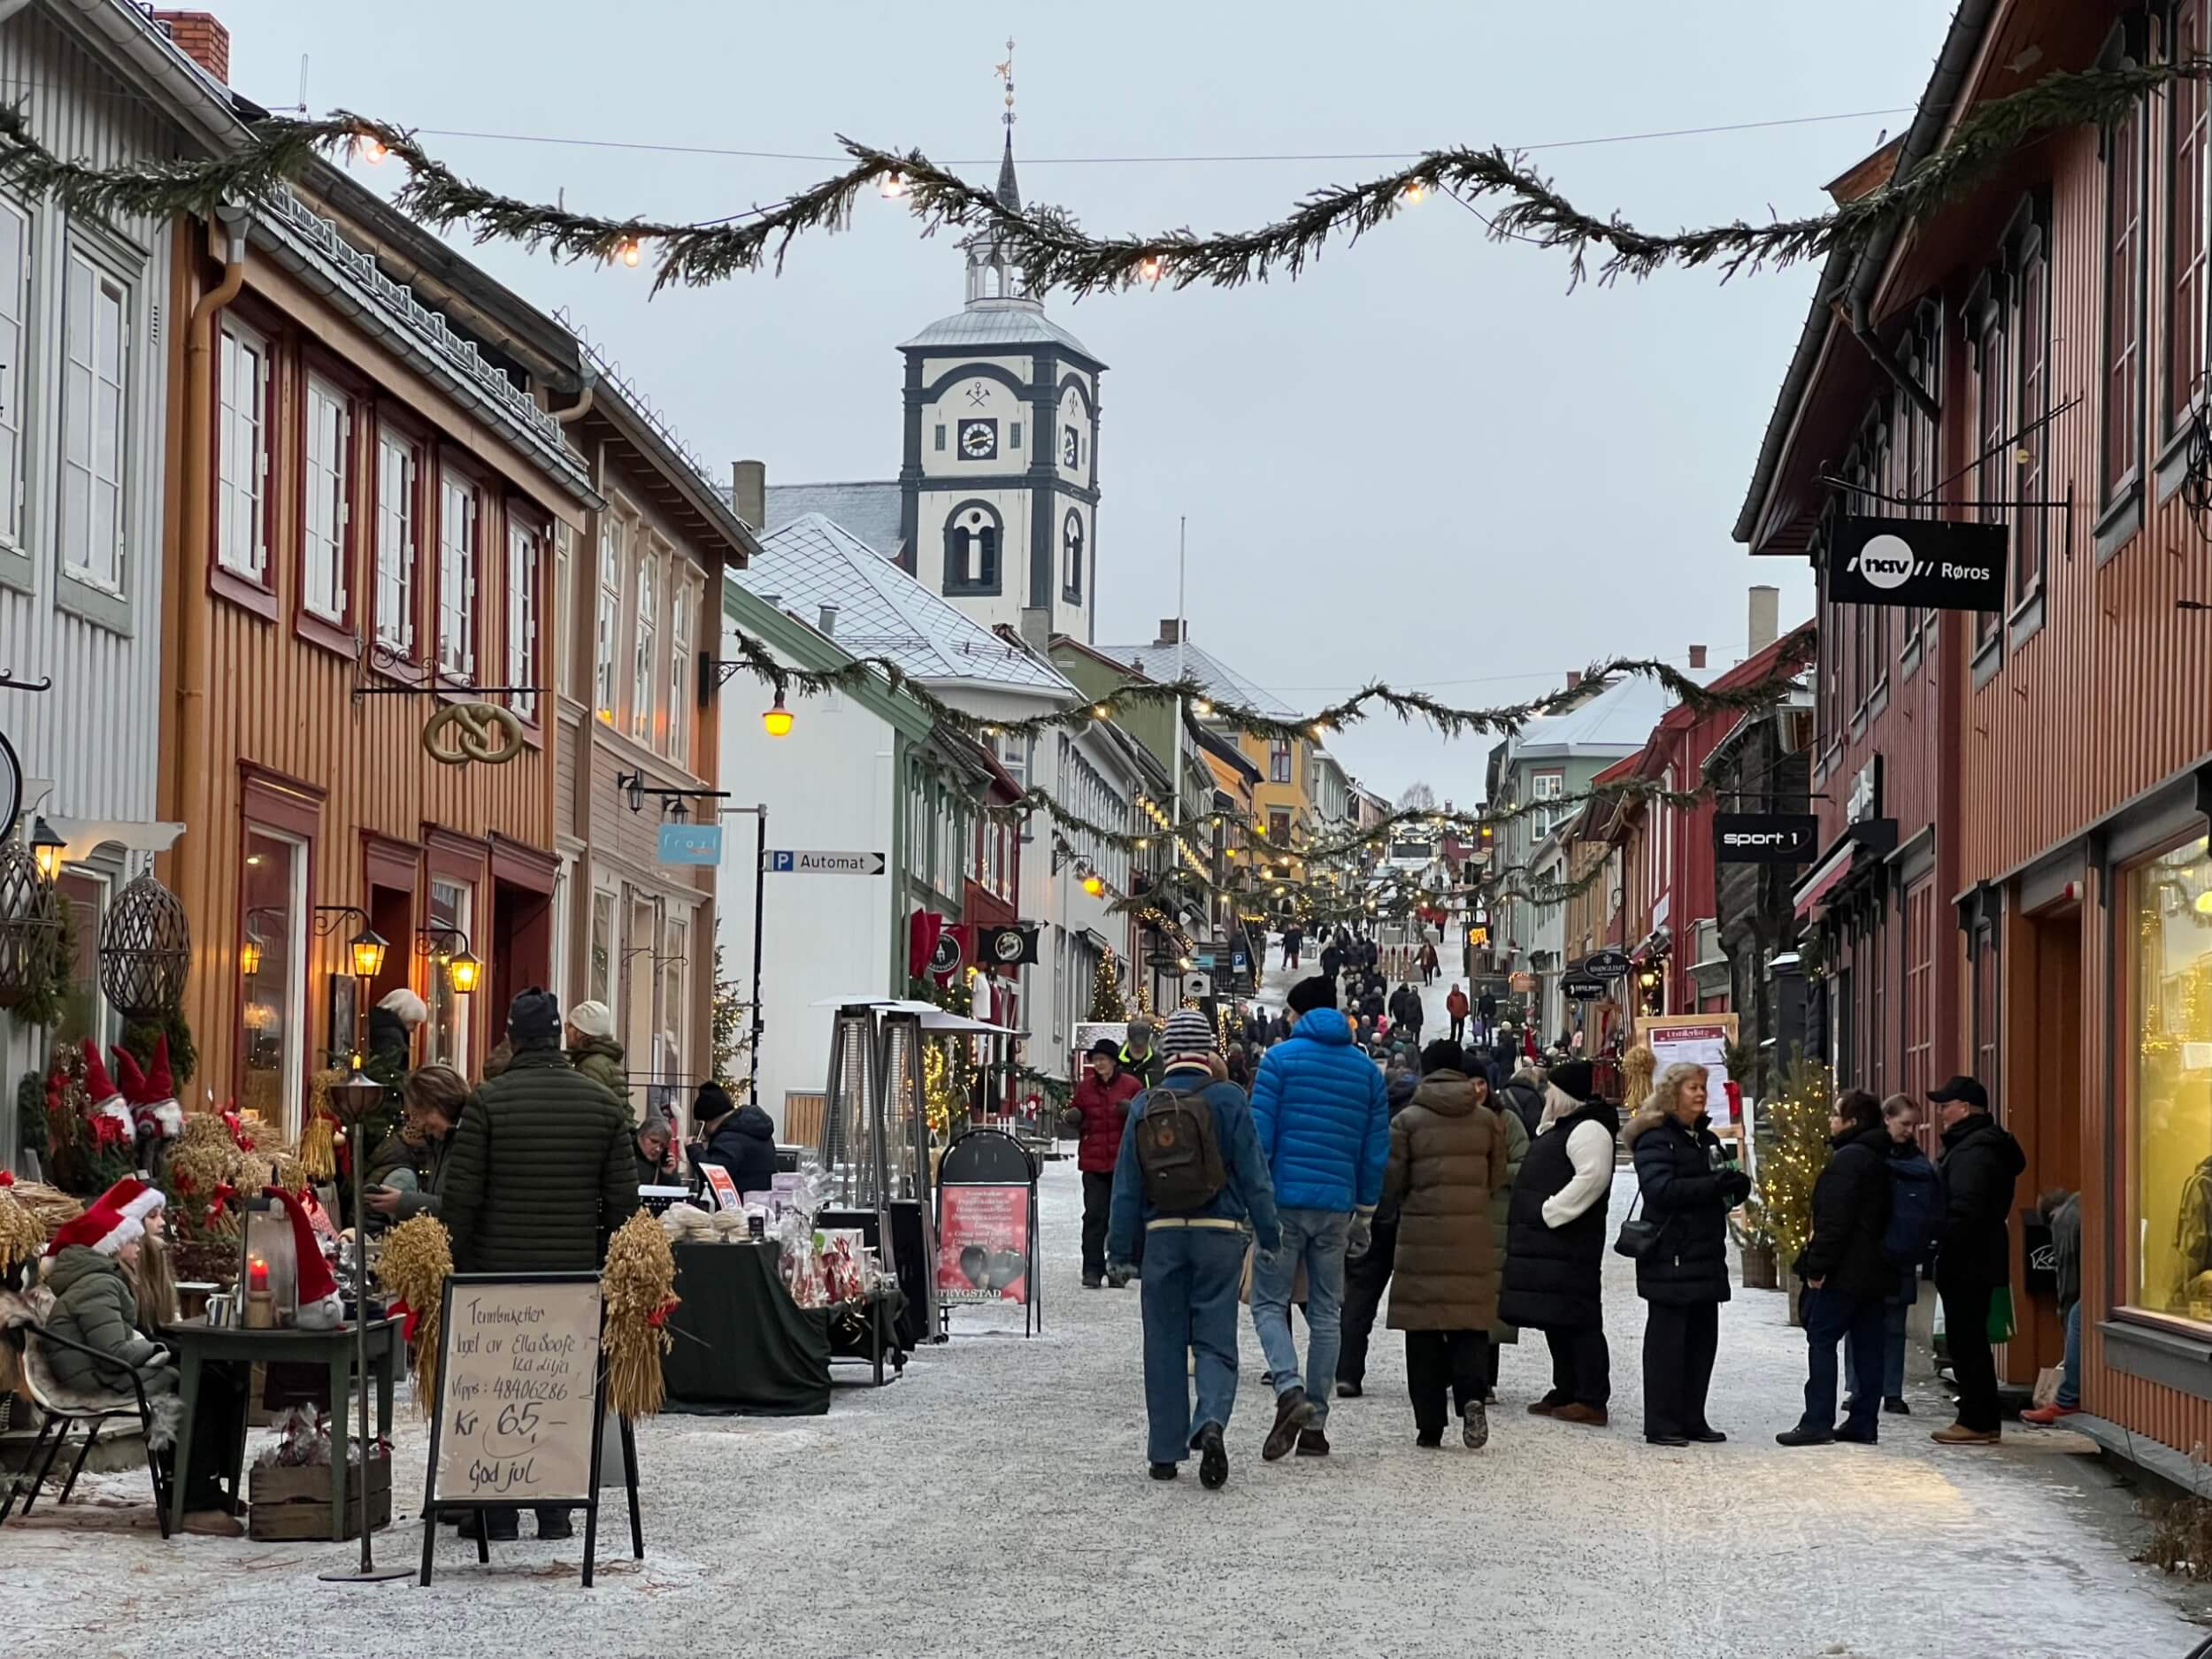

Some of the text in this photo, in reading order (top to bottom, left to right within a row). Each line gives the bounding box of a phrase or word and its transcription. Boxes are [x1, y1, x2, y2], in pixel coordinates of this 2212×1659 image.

[1865, 558, 1990, 580] nav Røros
[1724, 833, 1798, 847] sport 1
[778, 853, 864, 870] P Automat
[939, 1288, 1002, 1298] TRYGSTAD
[493, 1376, 567, 1401] 48406286
[455, 1409, 478, 1435] Kr
[469, 1458, 542, 1494] God jul
